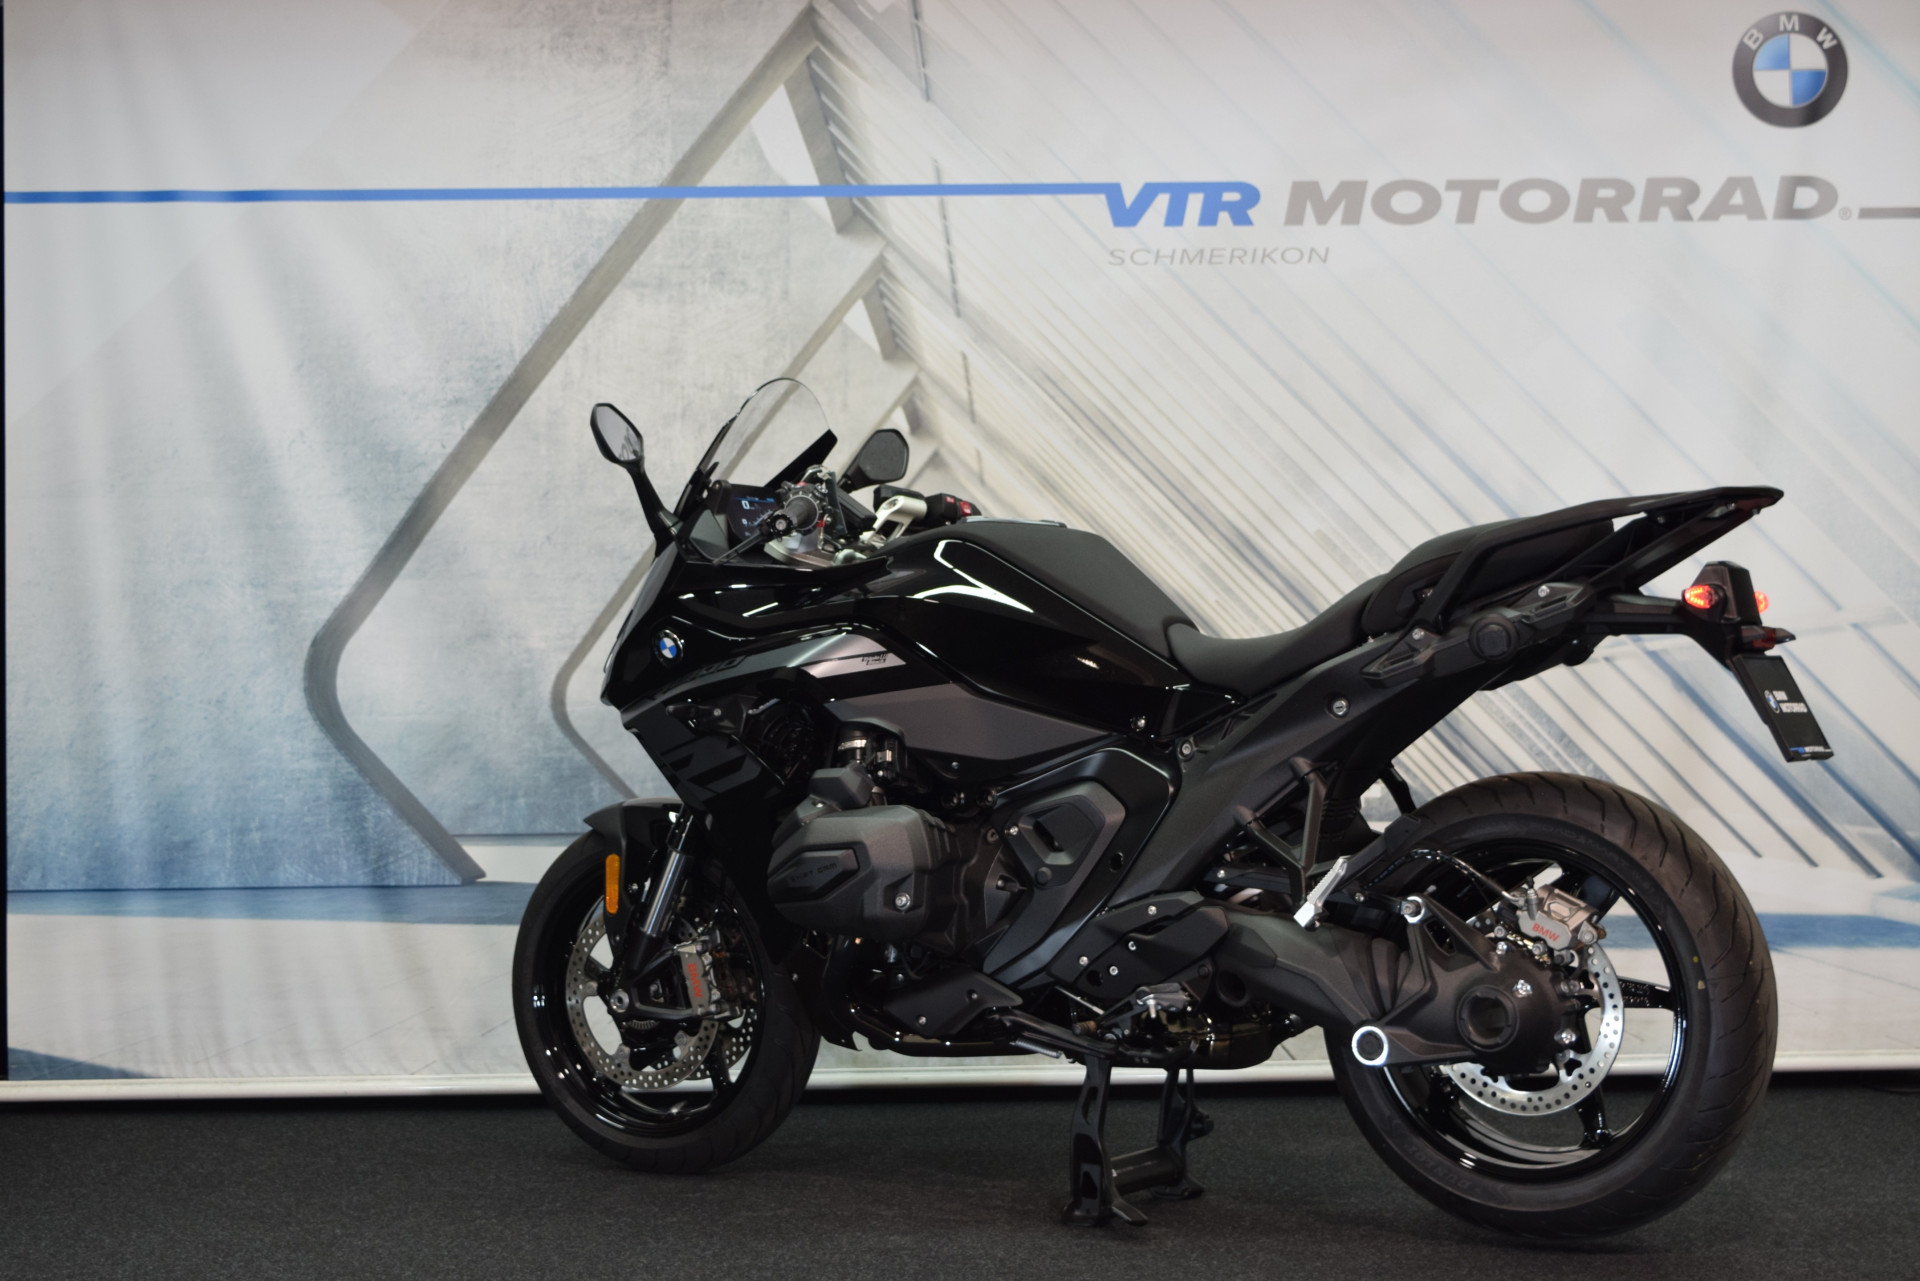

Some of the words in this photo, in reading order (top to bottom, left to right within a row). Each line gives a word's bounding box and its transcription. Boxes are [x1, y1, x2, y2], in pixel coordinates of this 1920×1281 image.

[1743, 14, 1838, 50] BMW
[1104, 181, 1261, 228] VTR
[1283, 175, 1839, 227] MOTORRAD
[1107, 247, 1331, 267] SCHMERIKON
[1532, 922, 1559, 942] BMW
[687, 962, 704, 998] BMW
